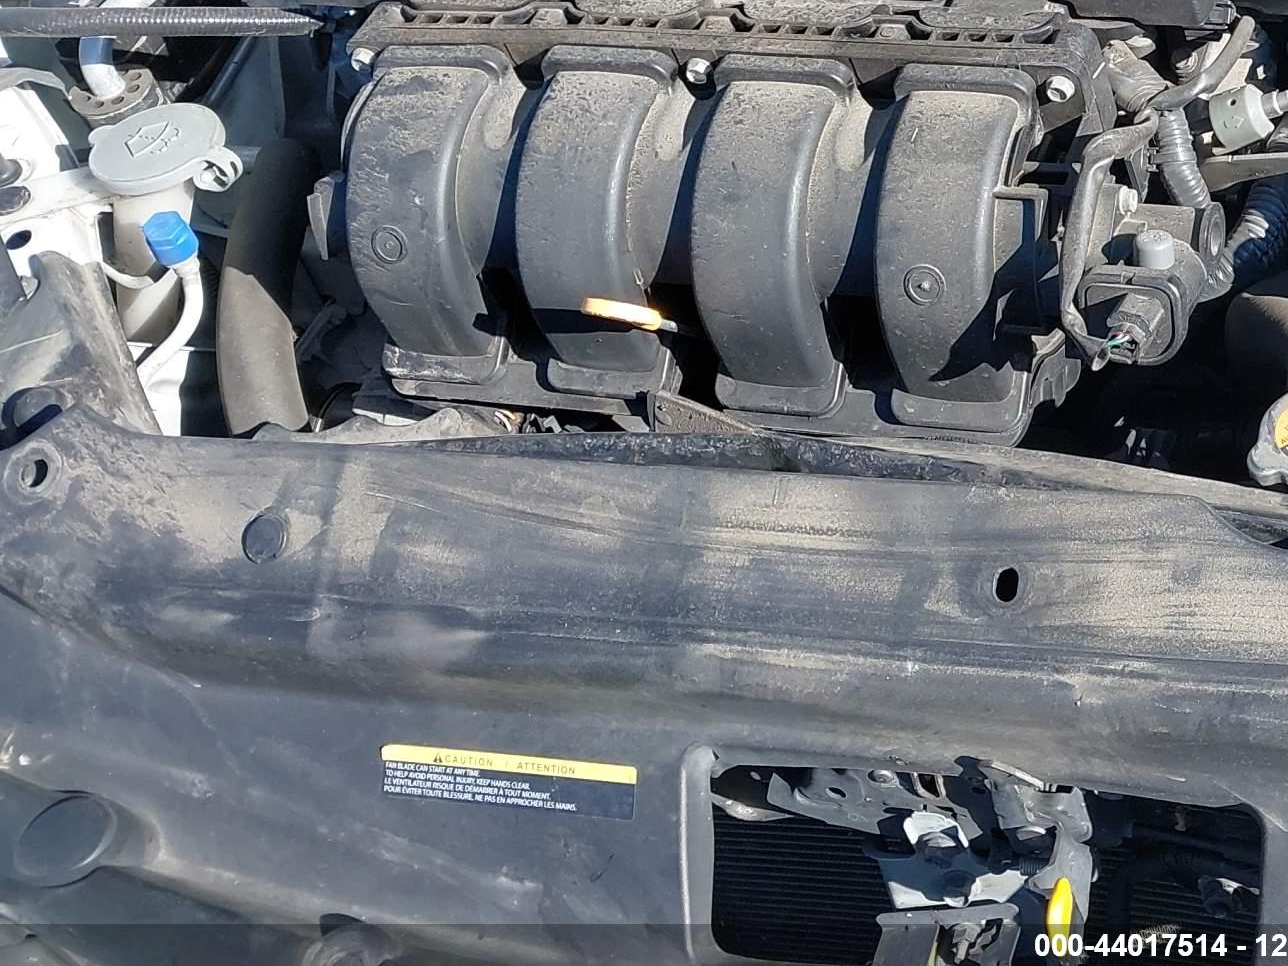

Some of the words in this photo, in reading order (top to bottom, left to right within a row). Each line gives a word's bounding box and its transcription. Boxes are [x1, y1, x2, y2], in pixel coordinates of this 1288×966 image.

[398, 763, 415, 771] BLADE
[416, 764, 428, 772] CAN
[429, 765, 446, 774] START
[444, 754, 494, 767] CAUTION
[516, 762, 576, 775] ATTENTION
[384, 777, 392, 785] LE
[392, 778, 432, 789] VENTILATEUR
[432, 781, 455, 791] RISQUE
[455, 783, 465, 792] DE
[503, 787, 522, 797] TOUT
[385, 769, 393, 777] TO
[393, 770, 408, 778] HELP
[408, 771, 426, 780] AVOID
[426, 773, 456, 783] PERSONAL
[476, 777, 491, 786] KEEP
[490, 778, 511, 788] HANDS
[383, 785, 401, 794] POUR
[422, 788, 443, 797] TOUTE
[474, 794, 484, 802] NE
[484, 794, 496, 803] PAS
[496, 795, 506, 804] EN
[506, 797, 544, 808] APPROCHER
[543, 800, 555, 809] LES
